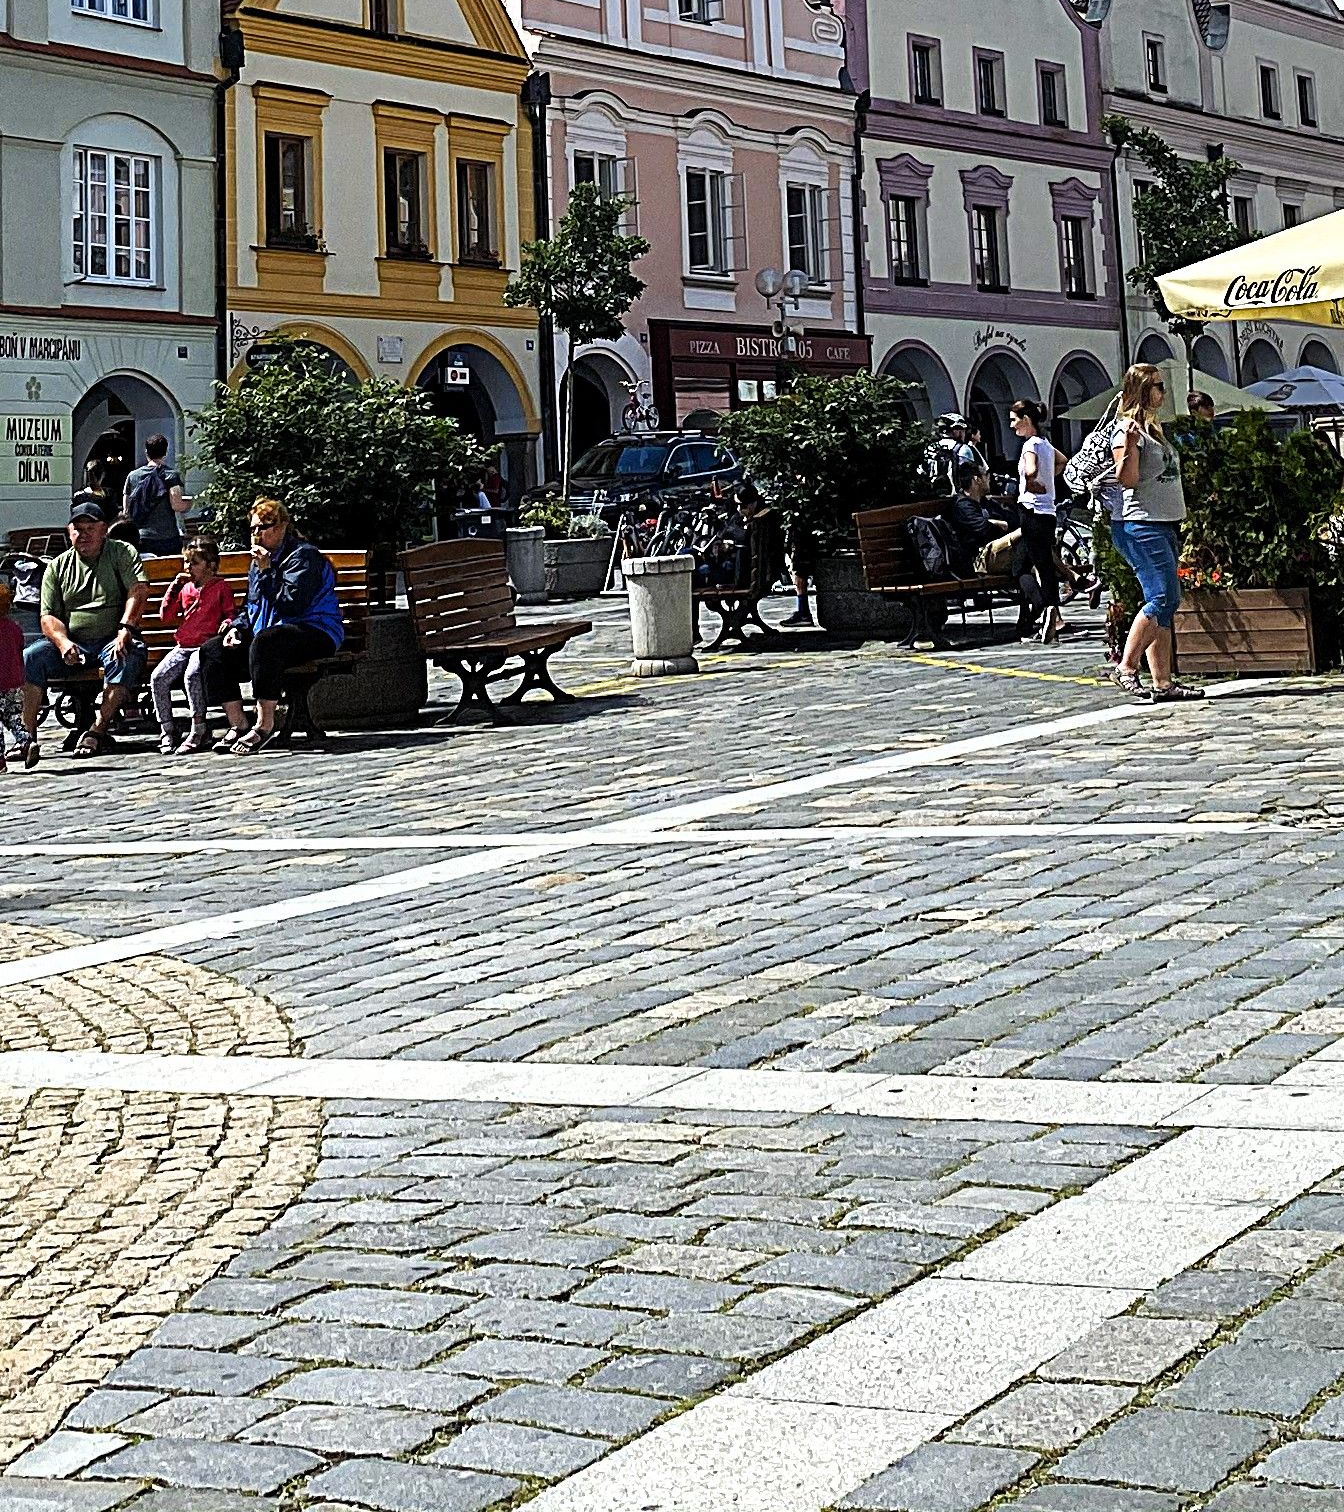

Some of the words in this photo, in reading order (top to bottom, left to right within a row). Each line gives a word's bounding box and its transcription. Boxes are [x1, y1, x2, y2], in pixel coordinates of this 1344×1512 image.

[1223, 264, 1323, 308] Coca-Cola
[19, 336, 27, 359] V
[29, 334, 81, 361] MARCIPÁNU
[689, 340, 721, 355] PIZZA
[6, 417, 62, 441] MUZEUM
[18, 457, 50, 483] DÍLNA
